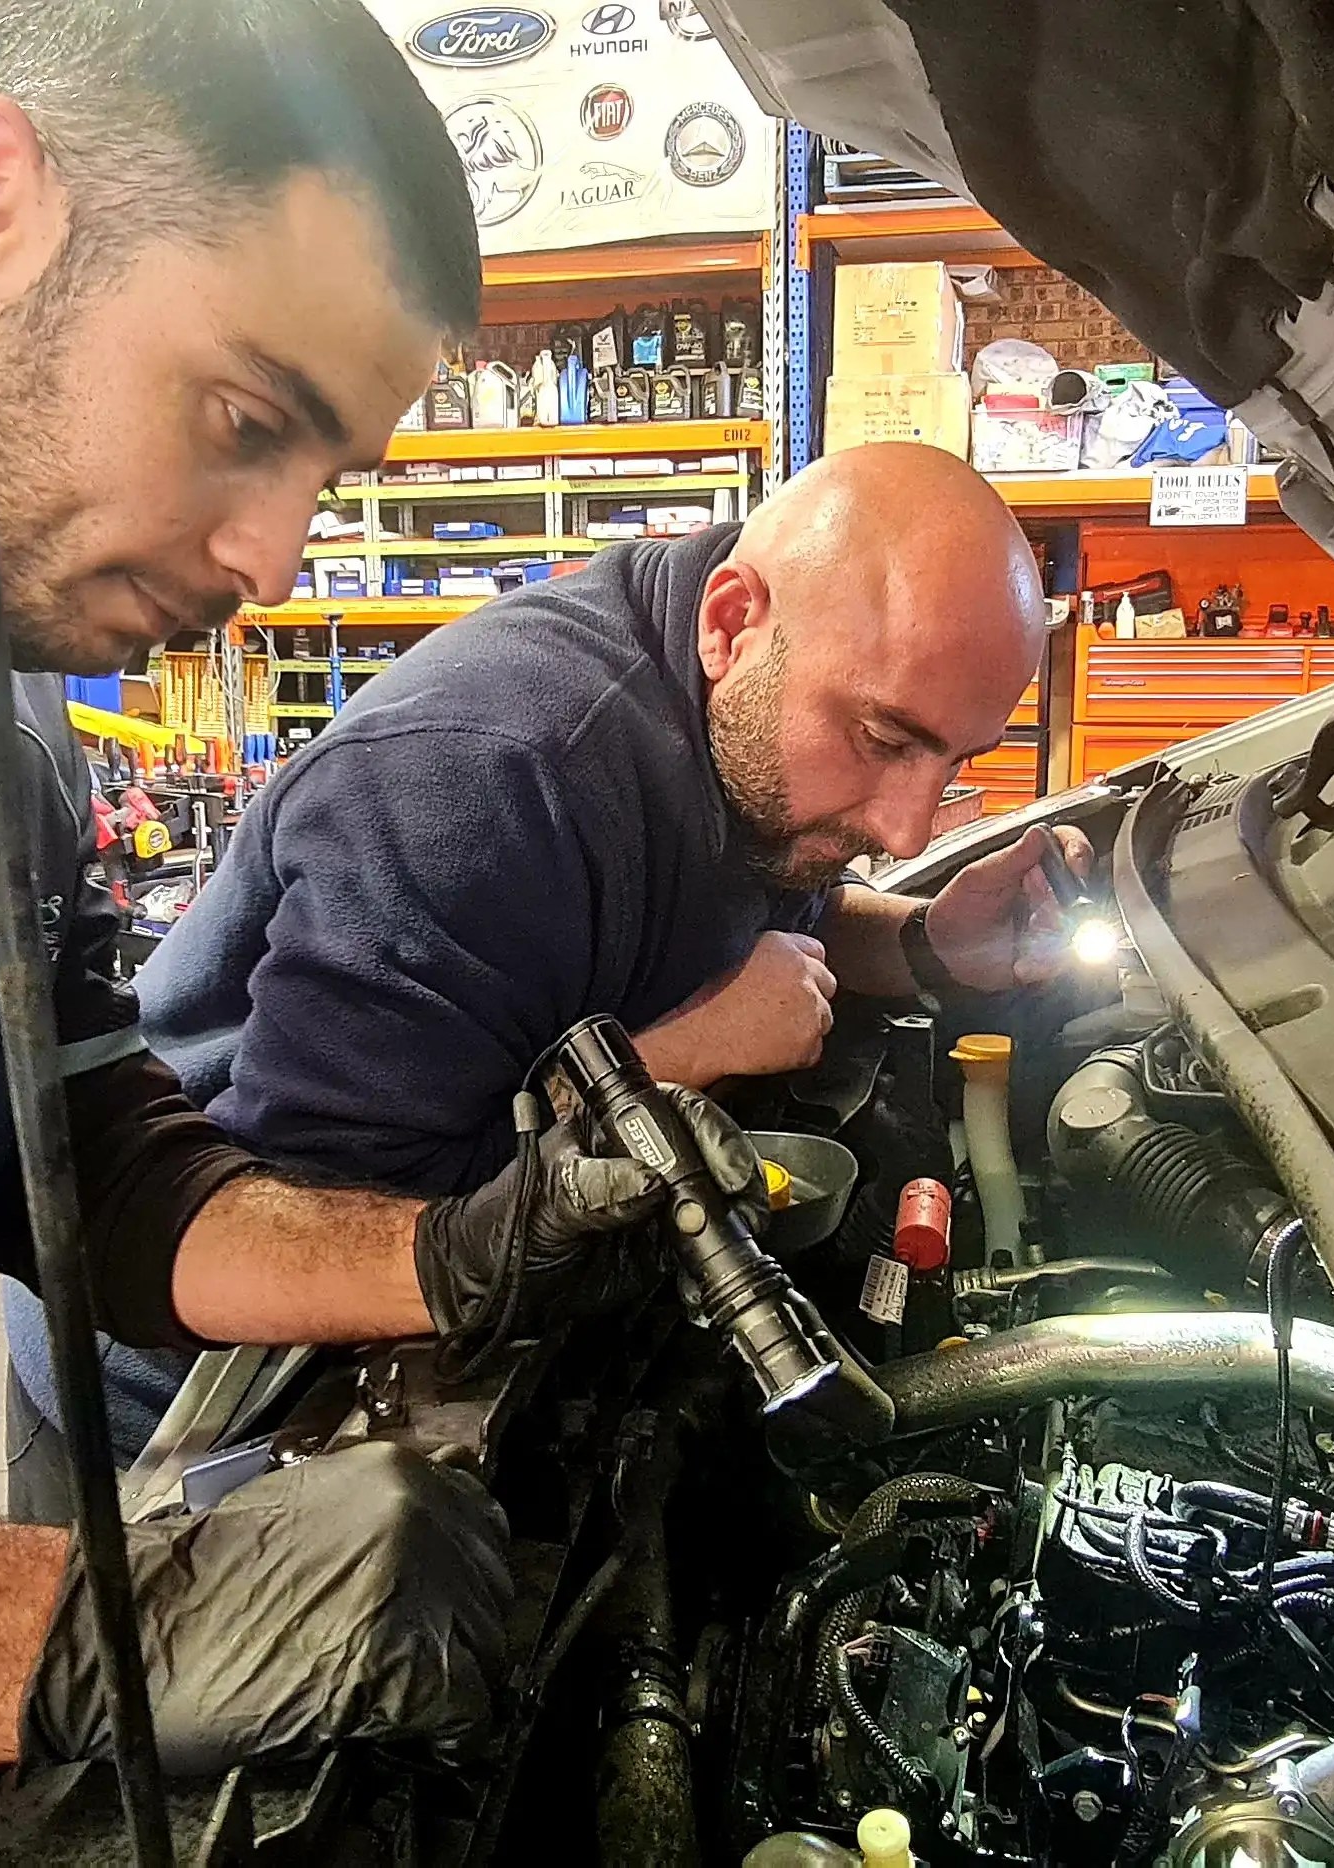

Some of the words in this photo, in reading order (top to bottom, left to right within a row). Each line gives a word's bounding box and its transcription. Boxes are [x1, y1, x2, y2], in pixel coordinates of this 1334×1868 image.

[439, 16, 521, 55] Ford
[569, 39, 649, 57] HYUNDAI
[593, 99, 625, 129] FIAT
[676, 102, 731, 124] MERCEDES
[688, 170, 721, 183] BENZ
[559, 180, 635, 206] JAGUAR
[1157, 475, 1192, 489] TOOL
[1197, 474, 1241, 488] RULES
